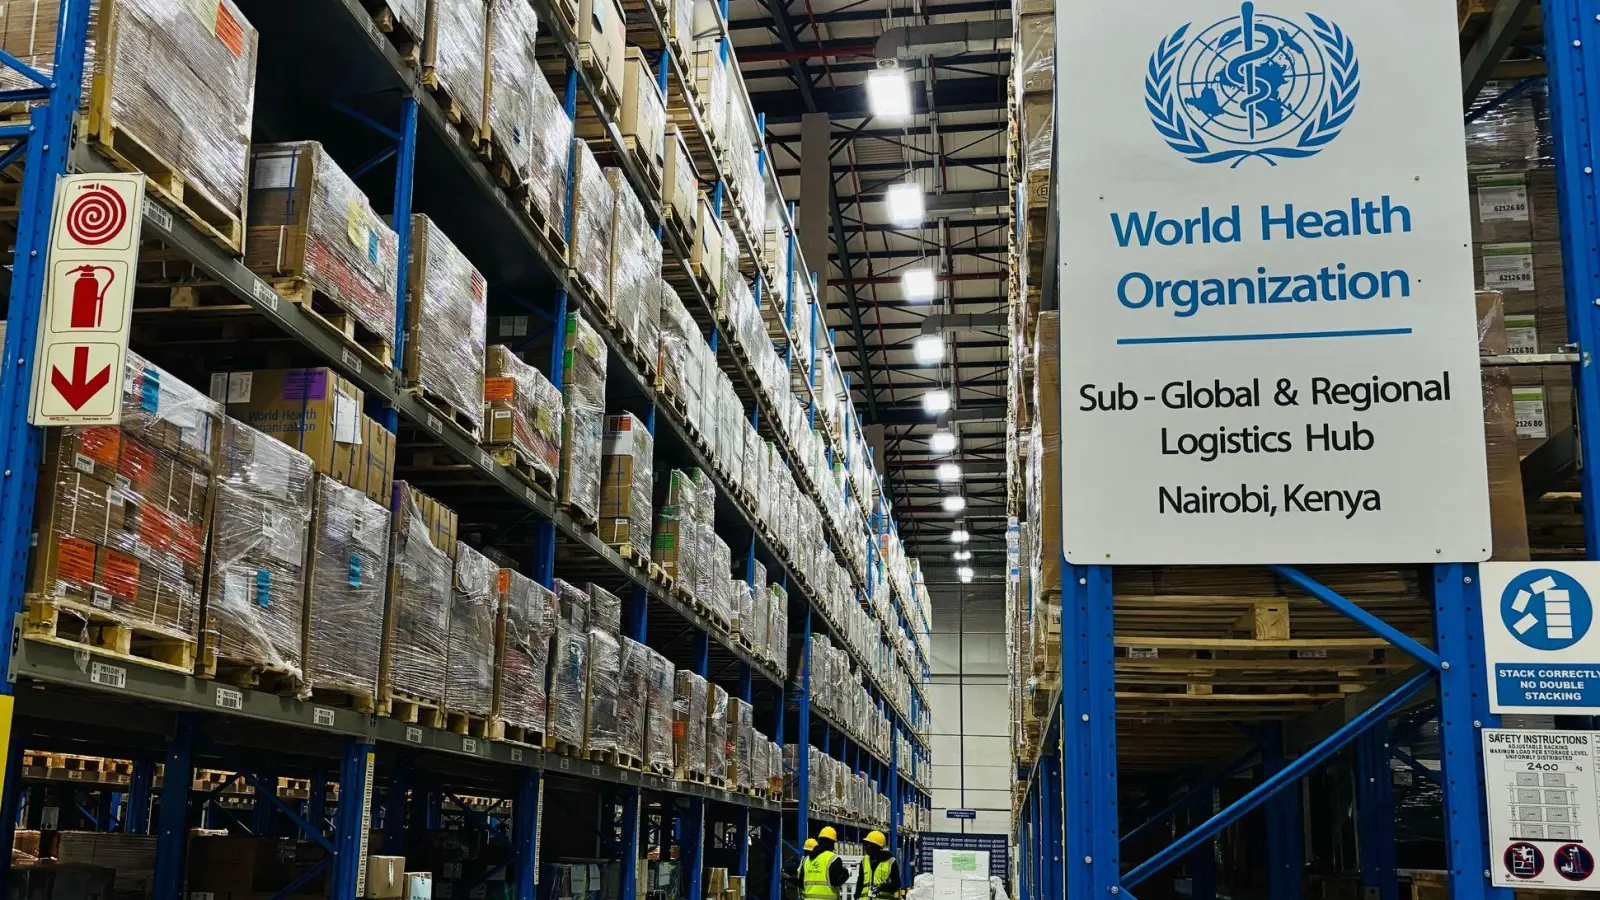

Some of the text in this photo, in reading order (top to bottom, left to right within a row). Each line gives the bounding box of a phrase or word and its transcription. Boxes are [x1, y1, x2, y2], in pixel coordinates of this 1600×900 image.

[1110, 196, 1411, 248] World Health
[1117, 263, 1410, 318] Organization
[1274, 378, 1300, 406] &
[1312, 371, 1451, 412] Regional
[249, 408, 316, 421] World Heath
[1162, 421, 1375, 461] Logistics Hub
[1159, 484, 1381, 519] Nairobi, Kenya
[1499, 669, 1600, 678] STACK CORRECTLY
[1520, 681, 1585, 690] NO DOUBLE
[1524, 692, 1582, 701] STACKING
[1489, 734, 1588, 745] SAFETY INSTRUCTIONS
[1526, 762, 1559, 771] 2400
